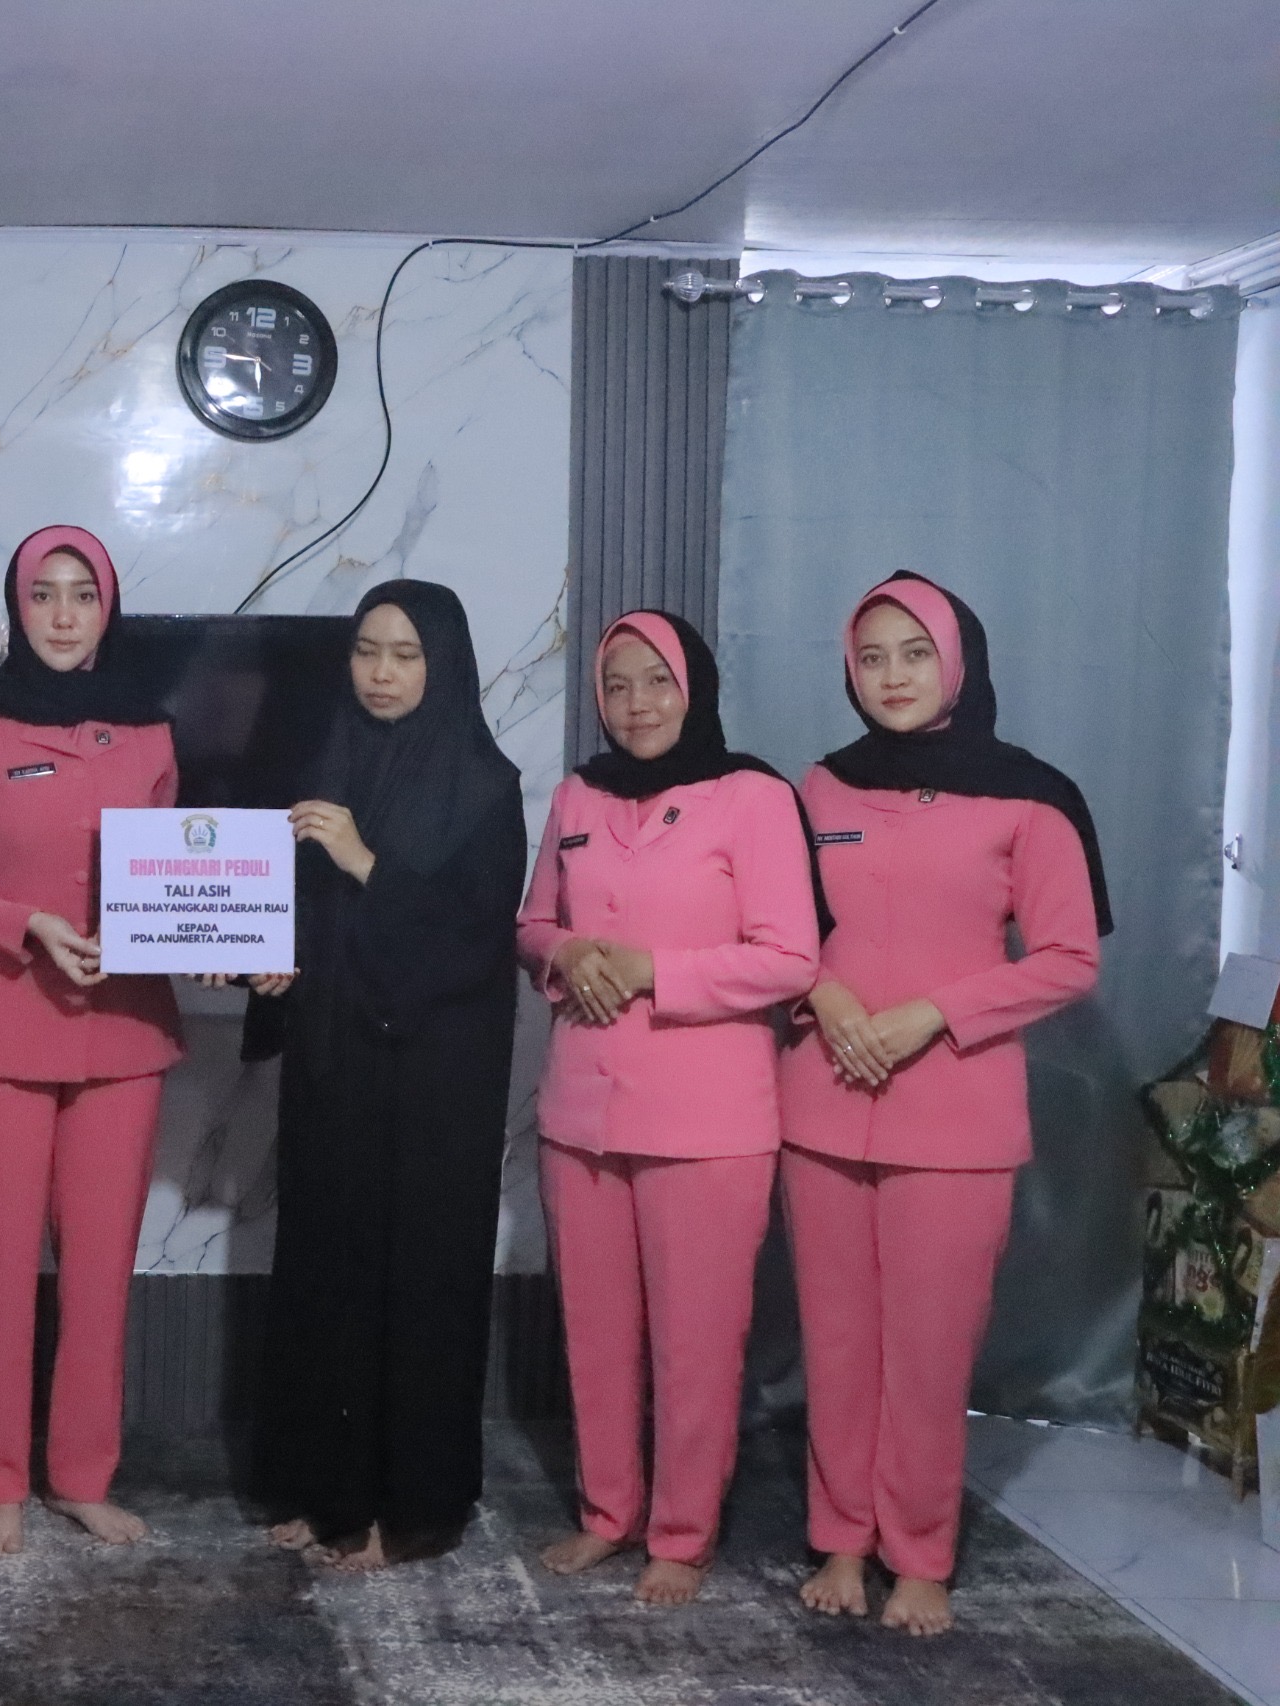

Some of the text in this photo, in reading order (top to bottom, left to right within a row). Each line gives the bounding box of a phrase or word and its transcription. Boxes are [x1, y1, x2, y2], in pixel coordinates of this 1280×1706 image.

[229, 311, 239, 322] 11
[246, 307, 276, 329] 12
[284, 316, 290, 327] 1
[211, 326, 227, 338] 10
[299, 334, 310, 345] 2
[204, 345, 227, 369] 9
[292, 353, 313, 376] 3
[294, 384, 304, 395] 4
[275, 401, 285, 412] 5
[129, 858, 270, 877] BHAYANGKARI PEDULI
[165, 885, 231, 898] TALI ASIH
[106, 902, 288, 913] KETUA BHAYANGKARI DAERAH RIAU
[177, 923, 219, 933] KEPADA
[130, 934, 265, 944] IPDA ANUMERTA APENDRA
